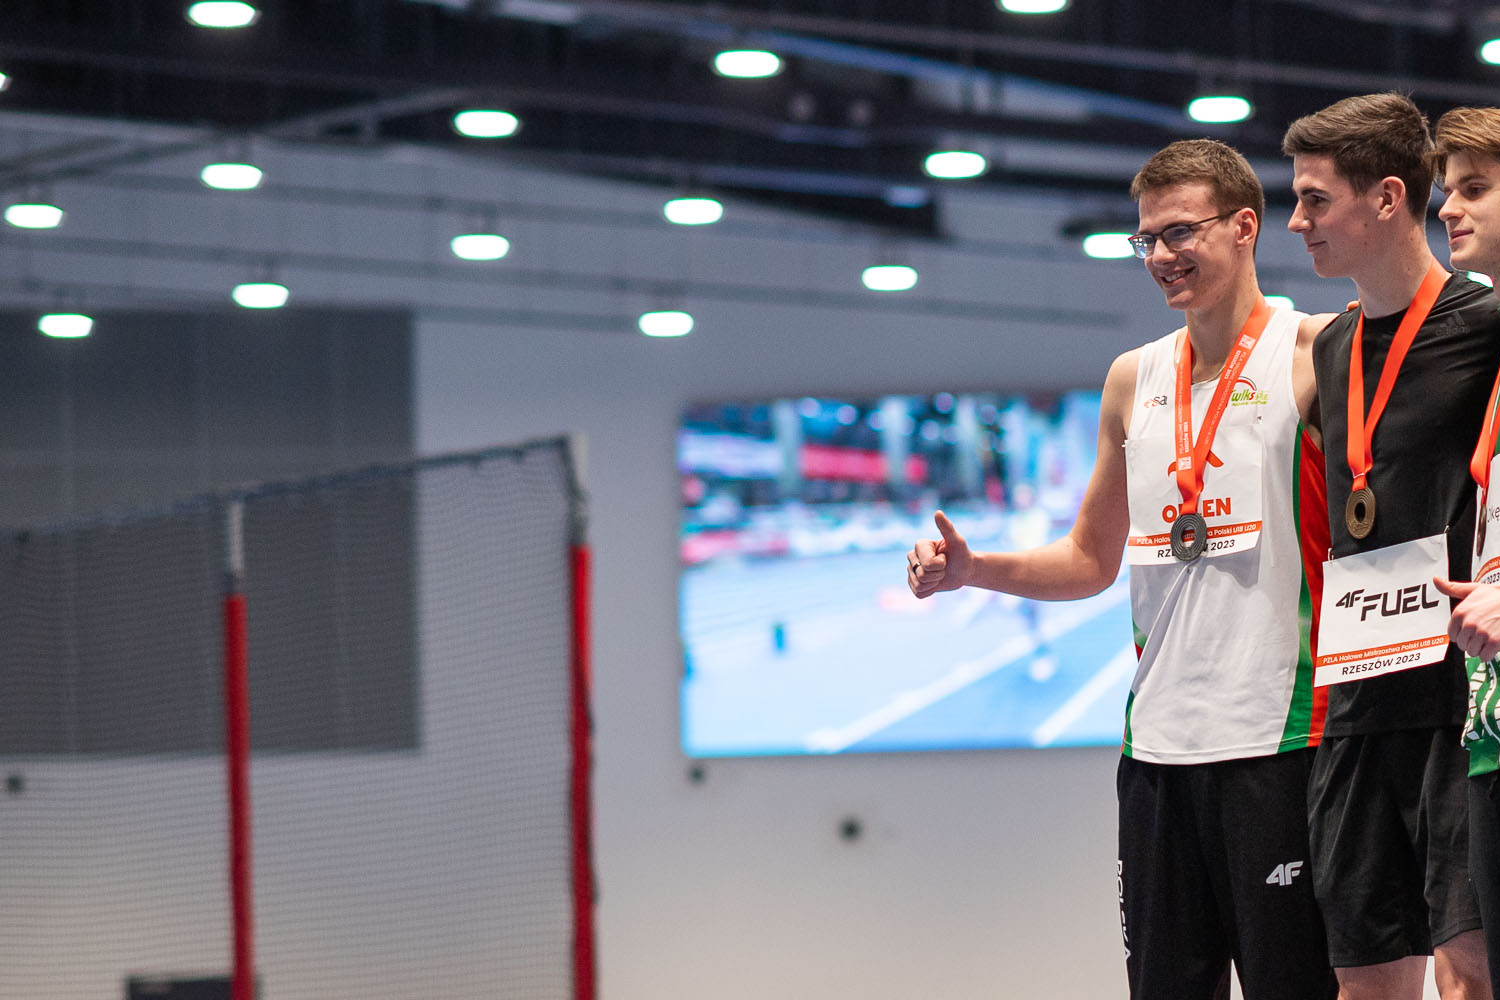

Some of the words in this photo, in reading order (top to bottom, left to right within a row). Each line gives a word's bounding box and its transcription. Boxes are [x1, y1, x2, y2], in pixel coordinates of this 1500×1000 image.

[1162, 497, 1231, 523] OEN
[1153, 536, 1171, 544] Halow
[1214, 527, 1233, 536] Polski
[1211, 539, 1235, 551] 2023
[1360, 583, 1440, 621] FUEL
[1341, 658, 1393, 676] RZESZÓW
[1396, 652, 1421, 665] 2023
